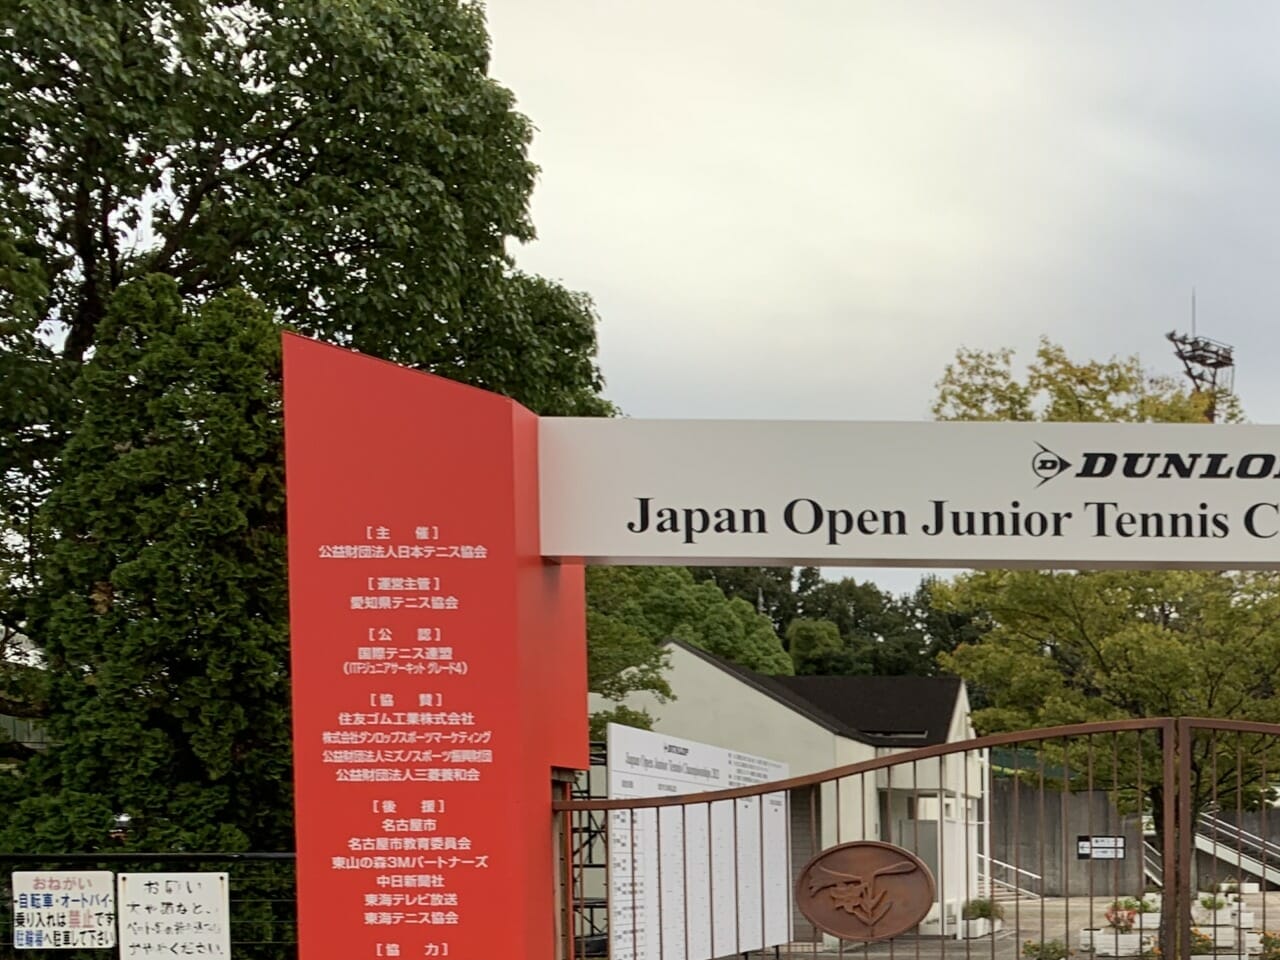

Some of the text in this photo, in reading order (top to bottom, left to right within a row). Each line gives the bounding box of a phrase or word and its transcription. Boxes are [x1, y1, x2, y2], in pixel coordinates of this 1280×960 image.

[628, 498, 766, 544] Japan
[784, 499, 906, 545] Open
[922, 501, 1072, 537] Junior
[1085, 503, 1228, 538] Tennis
[319, 545, 487, 559] 公益財団法人日本テニス協会
[350, 596, 458, 610] 愛知県テニス協会
[338, 712, 475, 726] 住友ゴム工業株式会社
[382, 819, 437, 832] 名古屋市
[348, 837, 471, 851] 名古屋市教育委員会
[32, 876, 93, 890] おねがい
[376, 875, 445, 888] 中日新聞社
[364, 893, 458, 907] 東海テレビ放送
[364, 911, 458, 926] 東海テニス協会
